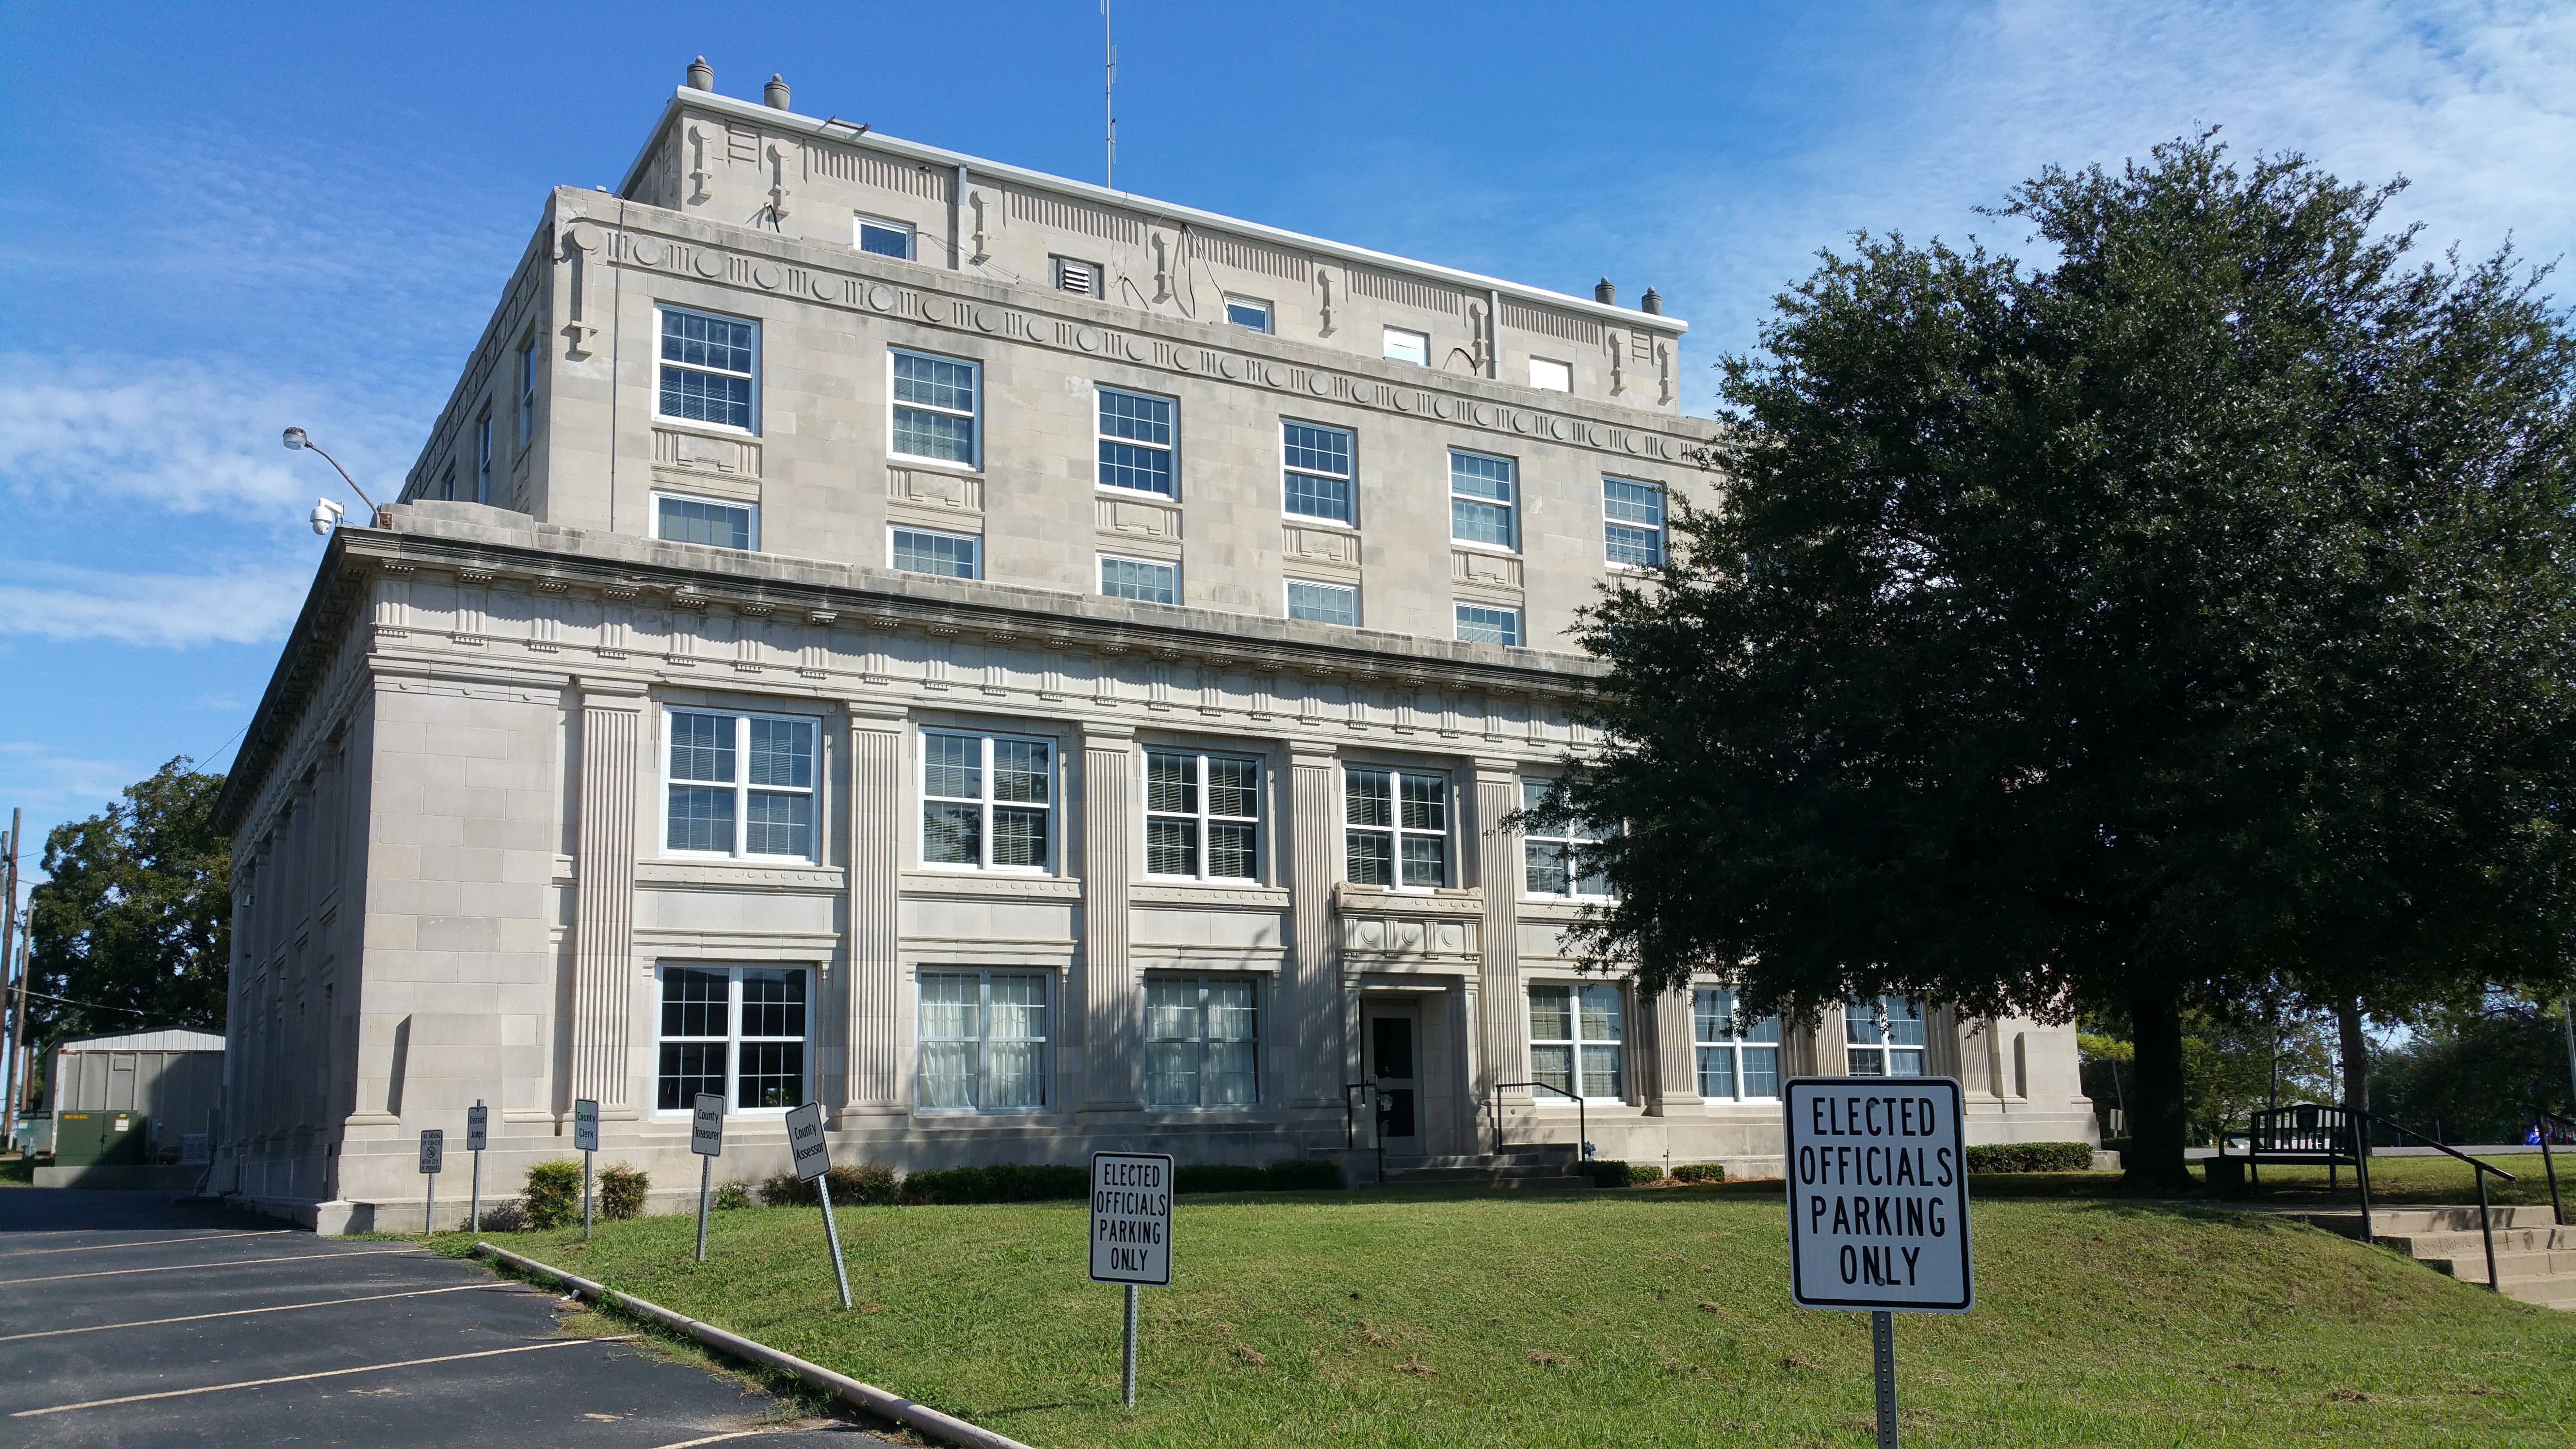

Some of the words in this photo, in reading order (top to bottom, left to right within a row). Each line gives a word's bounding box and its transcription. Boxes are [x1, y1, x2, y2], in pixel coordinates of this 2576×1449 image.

[577, 1111, 596, 1125] County
[698, 1109, 719, 1124] County
[1812, 1097, 1935, 1136] ELECTED
[470, 1130, 483, 1140] Judge
[579, 1128, 594, 1139] Clerk
[695, 1126, 720, 1140] Treasurer
[794, 1122, 817, 1140] County
[796, 1142, 823, 1161] Assessor
[1104, 1163, 1160, 1187] ELECTED
[1800, 1145, 1953, 1187] OFFICIALS
[1096, 1191, 1166, 1217] OFFICIALS
[1811, 1196, 1945, 1238] PARKING
[1100, 1219, 1160, 1244] PARKING
[1111, 1247, 1148, 1272] ONLY
[1840, 1244, 1920, 1286] ONLY
